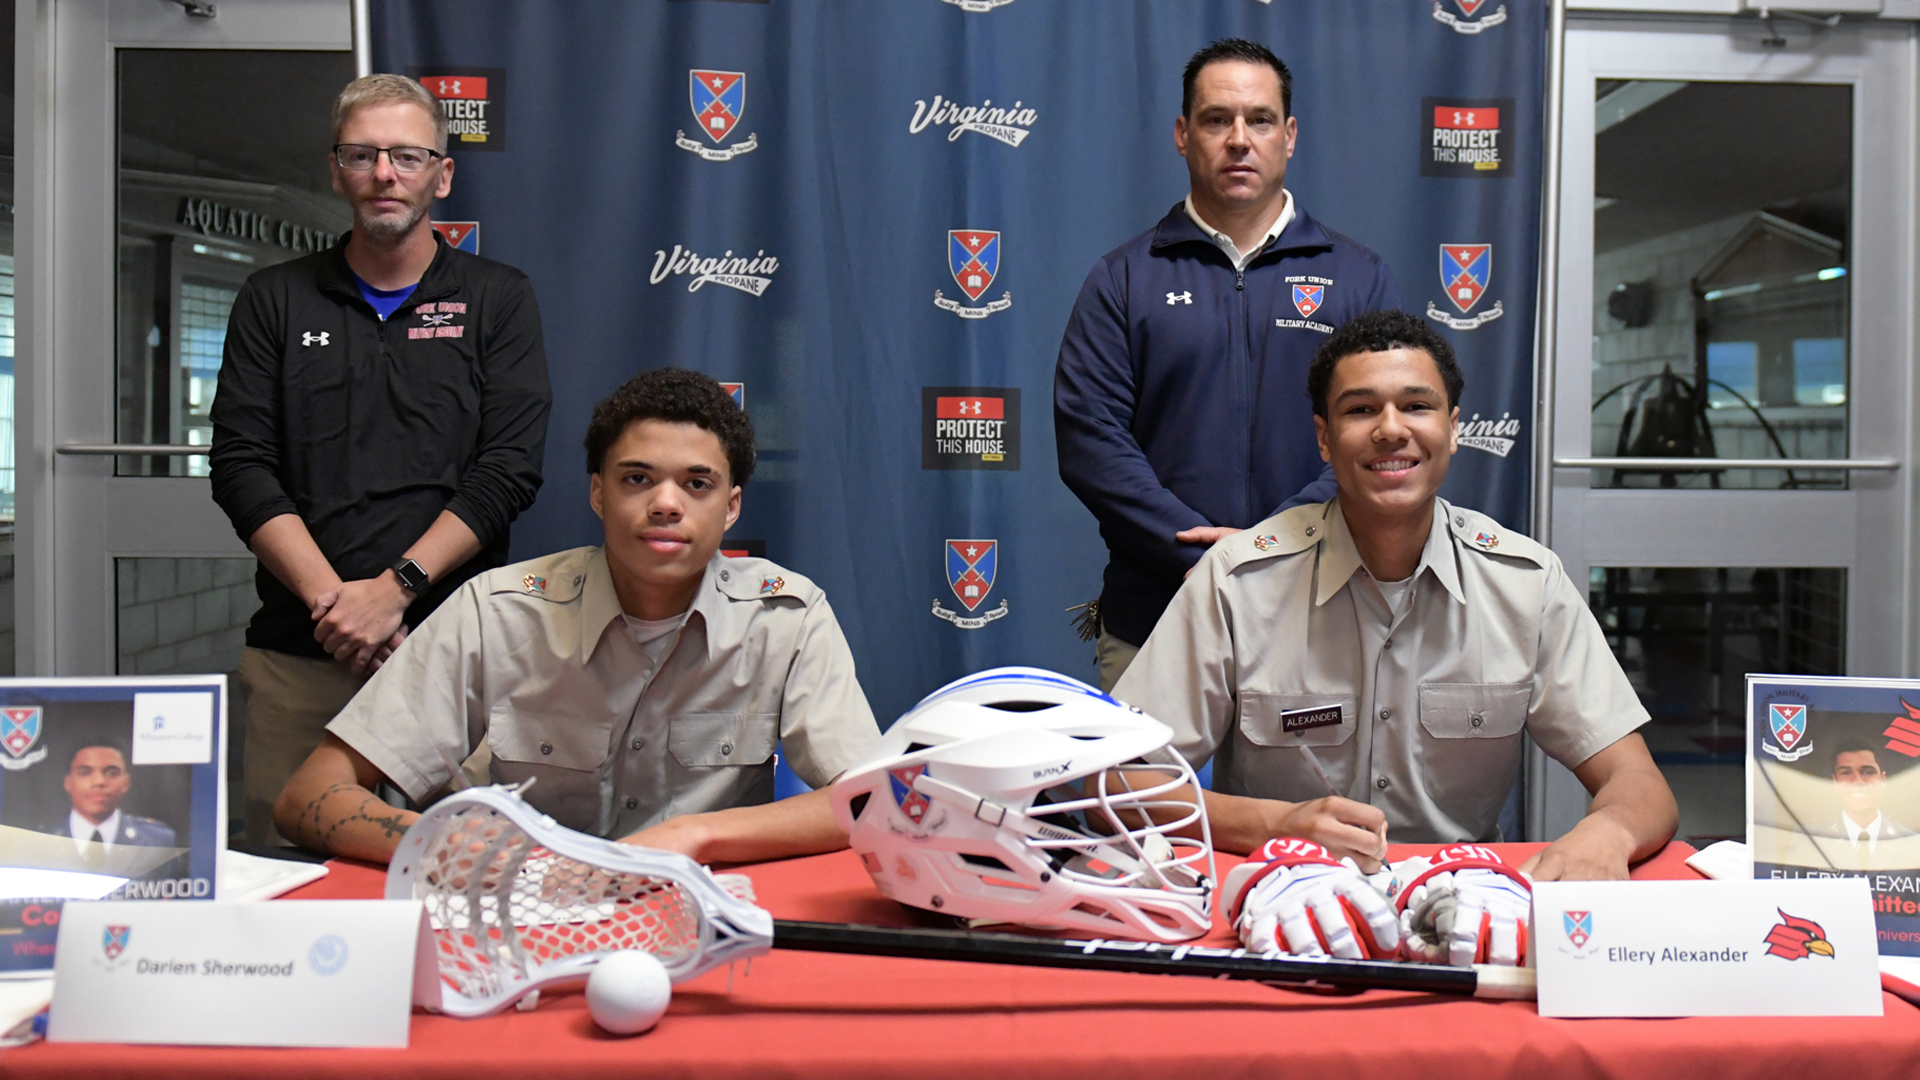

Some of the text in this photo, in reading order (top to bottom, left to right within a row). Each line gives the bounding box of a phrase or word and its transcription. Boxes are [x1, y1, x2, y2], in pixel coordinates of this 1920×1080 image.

[909, 95, 1038, 142] Virginia
[974, 124, 1016, 144] PROPANE
[1433, 128, 1498, 148] PROTECT
[1433, 147, 1456, 162] THIS
[184, 197, 344, 252] AQUATIC CENTE
[650, 244, 779, 293] Virginia
[715, 275, 759, 293] PROPANE
[1307, 276, 1334, 286] UNION
[415, 303, 436, 314] ORK
[1275, 319, 1335, 334] MILITARY ACADEMY
[936, 420, 1004, 438] PROTECT
[936, 439, 1007, 454] THIS HOUSE.
[1462, 438, 1505, 454] PROPANE
[1286, 711, 1338, 727] ALEXANDER
[1608, 947, 1656, 966] Ellery
[1661, 947, 1749, 962] Alexander
[137, 958, 196, 976] Darien
[201, 960, 294, 977] Sherwood
